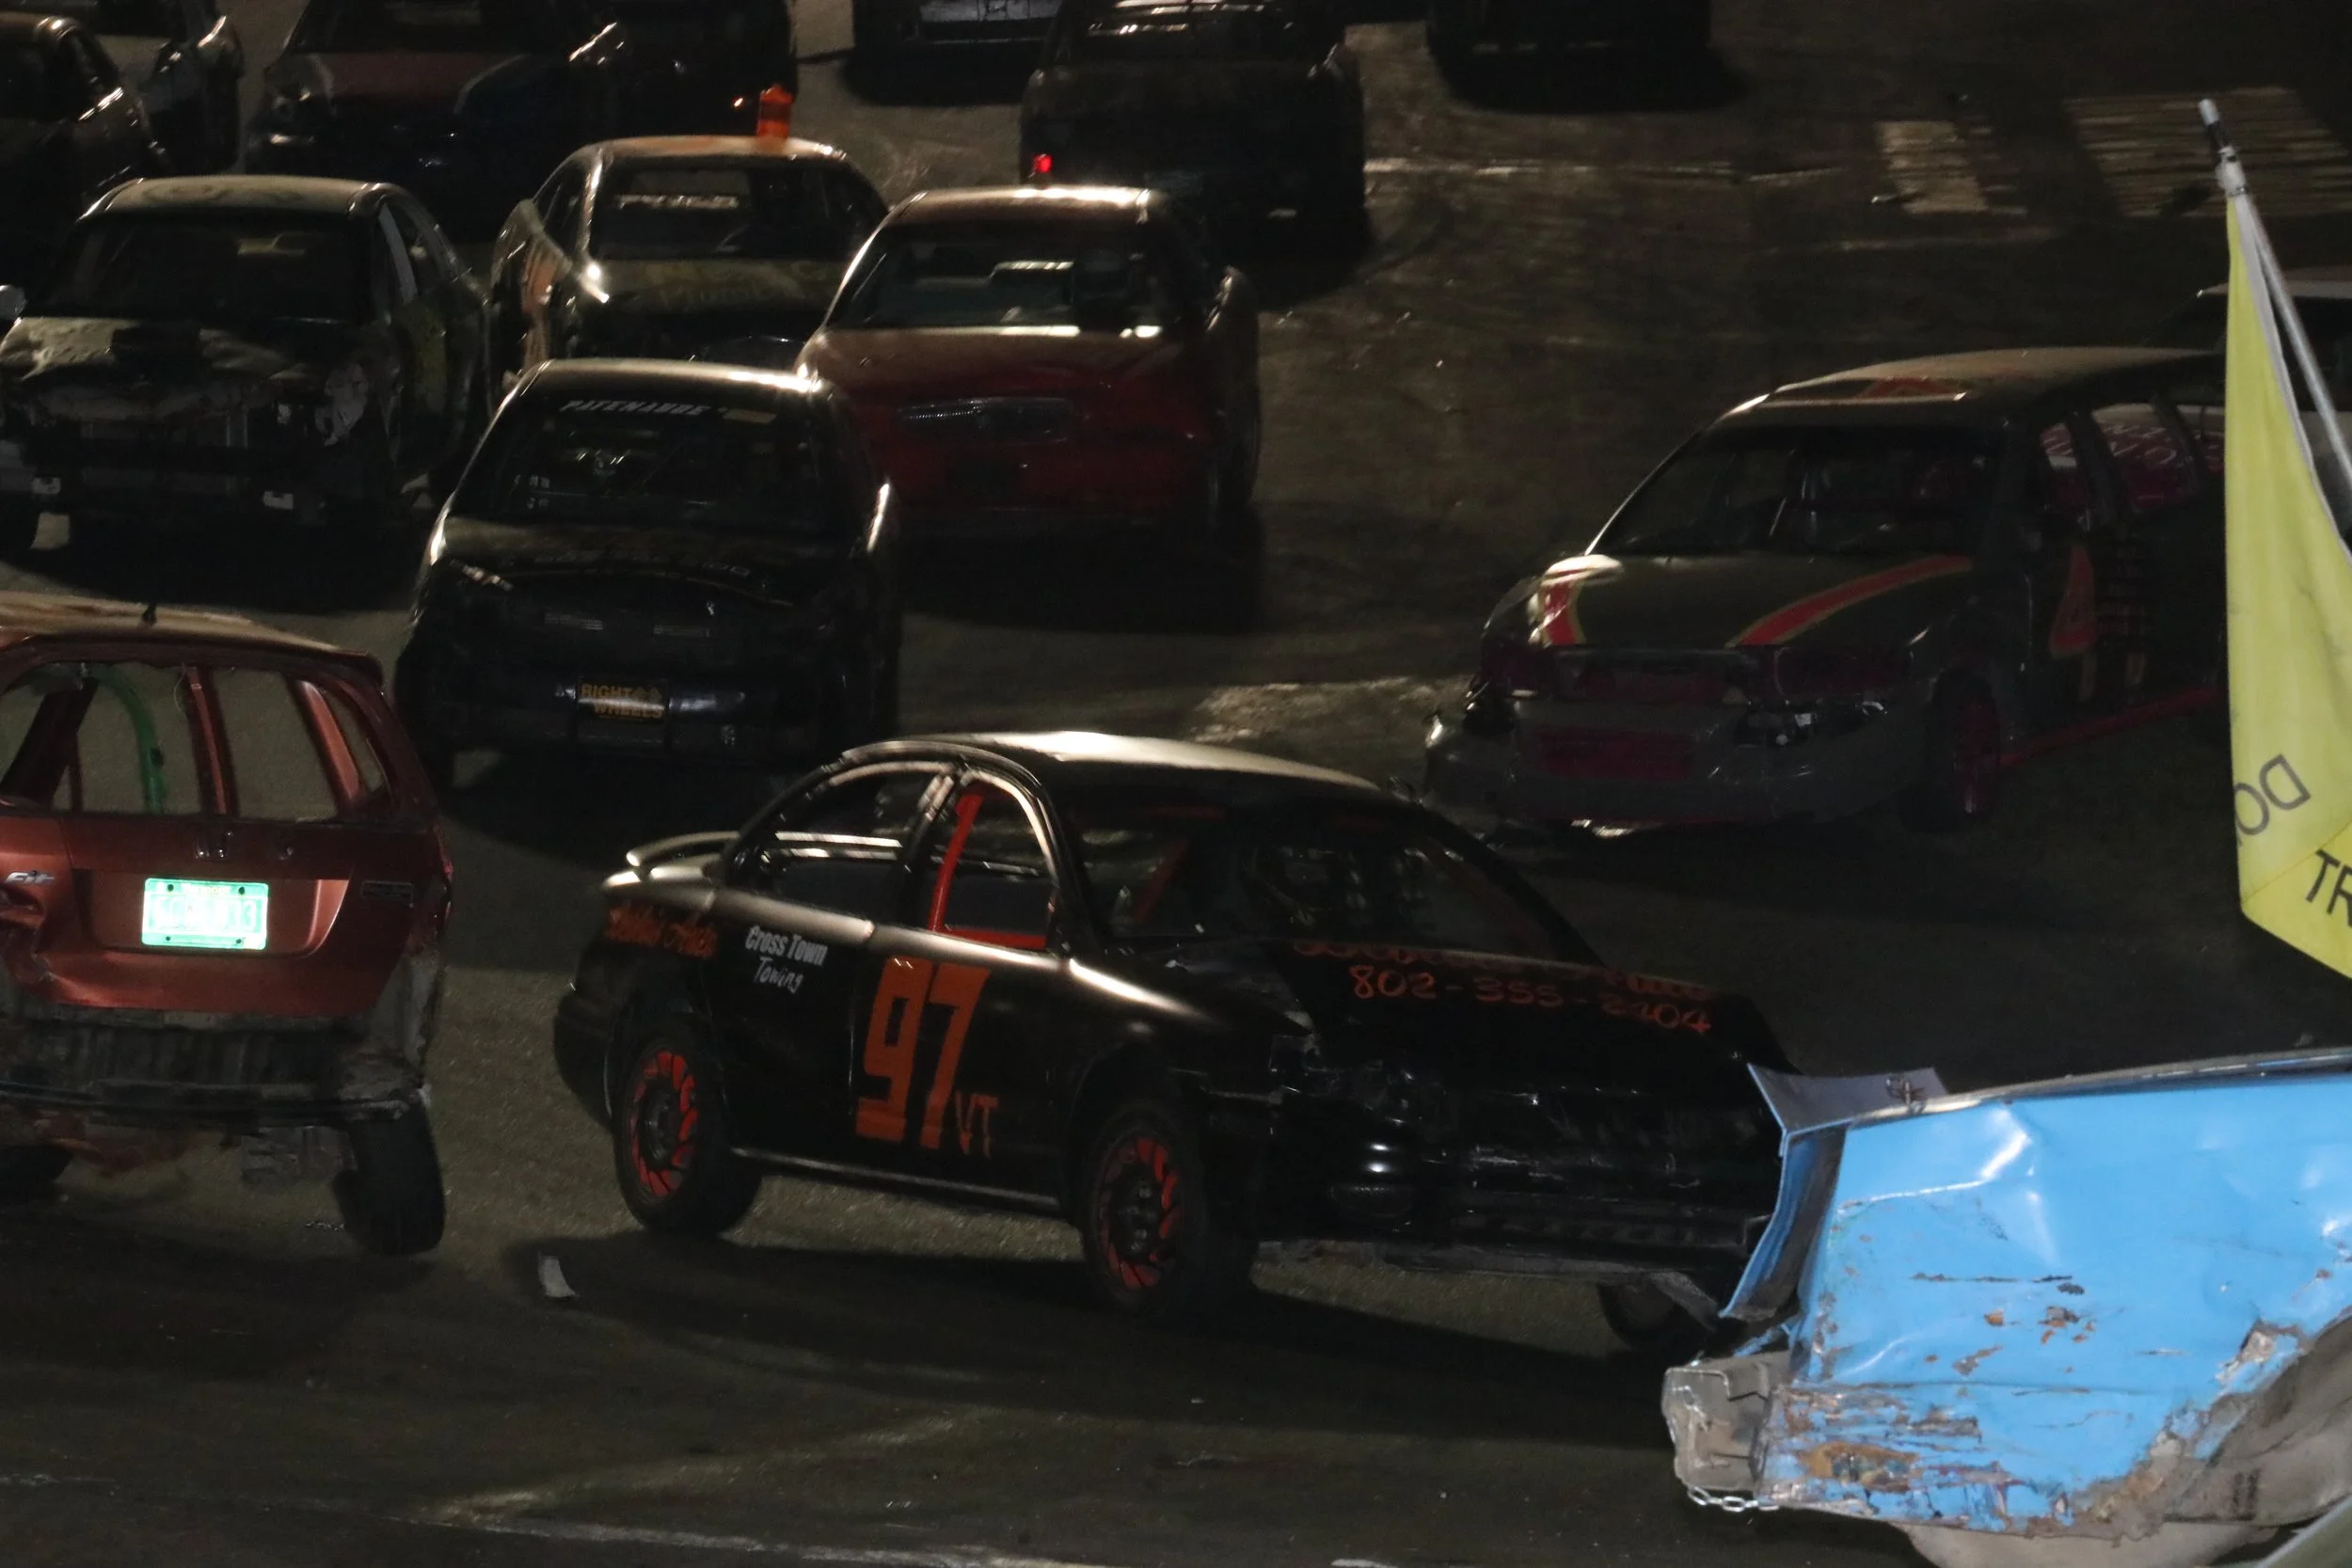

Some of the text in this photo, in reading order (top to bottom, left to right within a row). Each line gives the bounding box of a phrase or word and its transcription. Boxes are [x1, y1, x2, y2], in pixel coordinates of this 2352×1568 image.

[579, 684, 632, 699] RIGHT
[856, 955, 991, 1149] 97
[955, 1089, 998, 1158] VT
